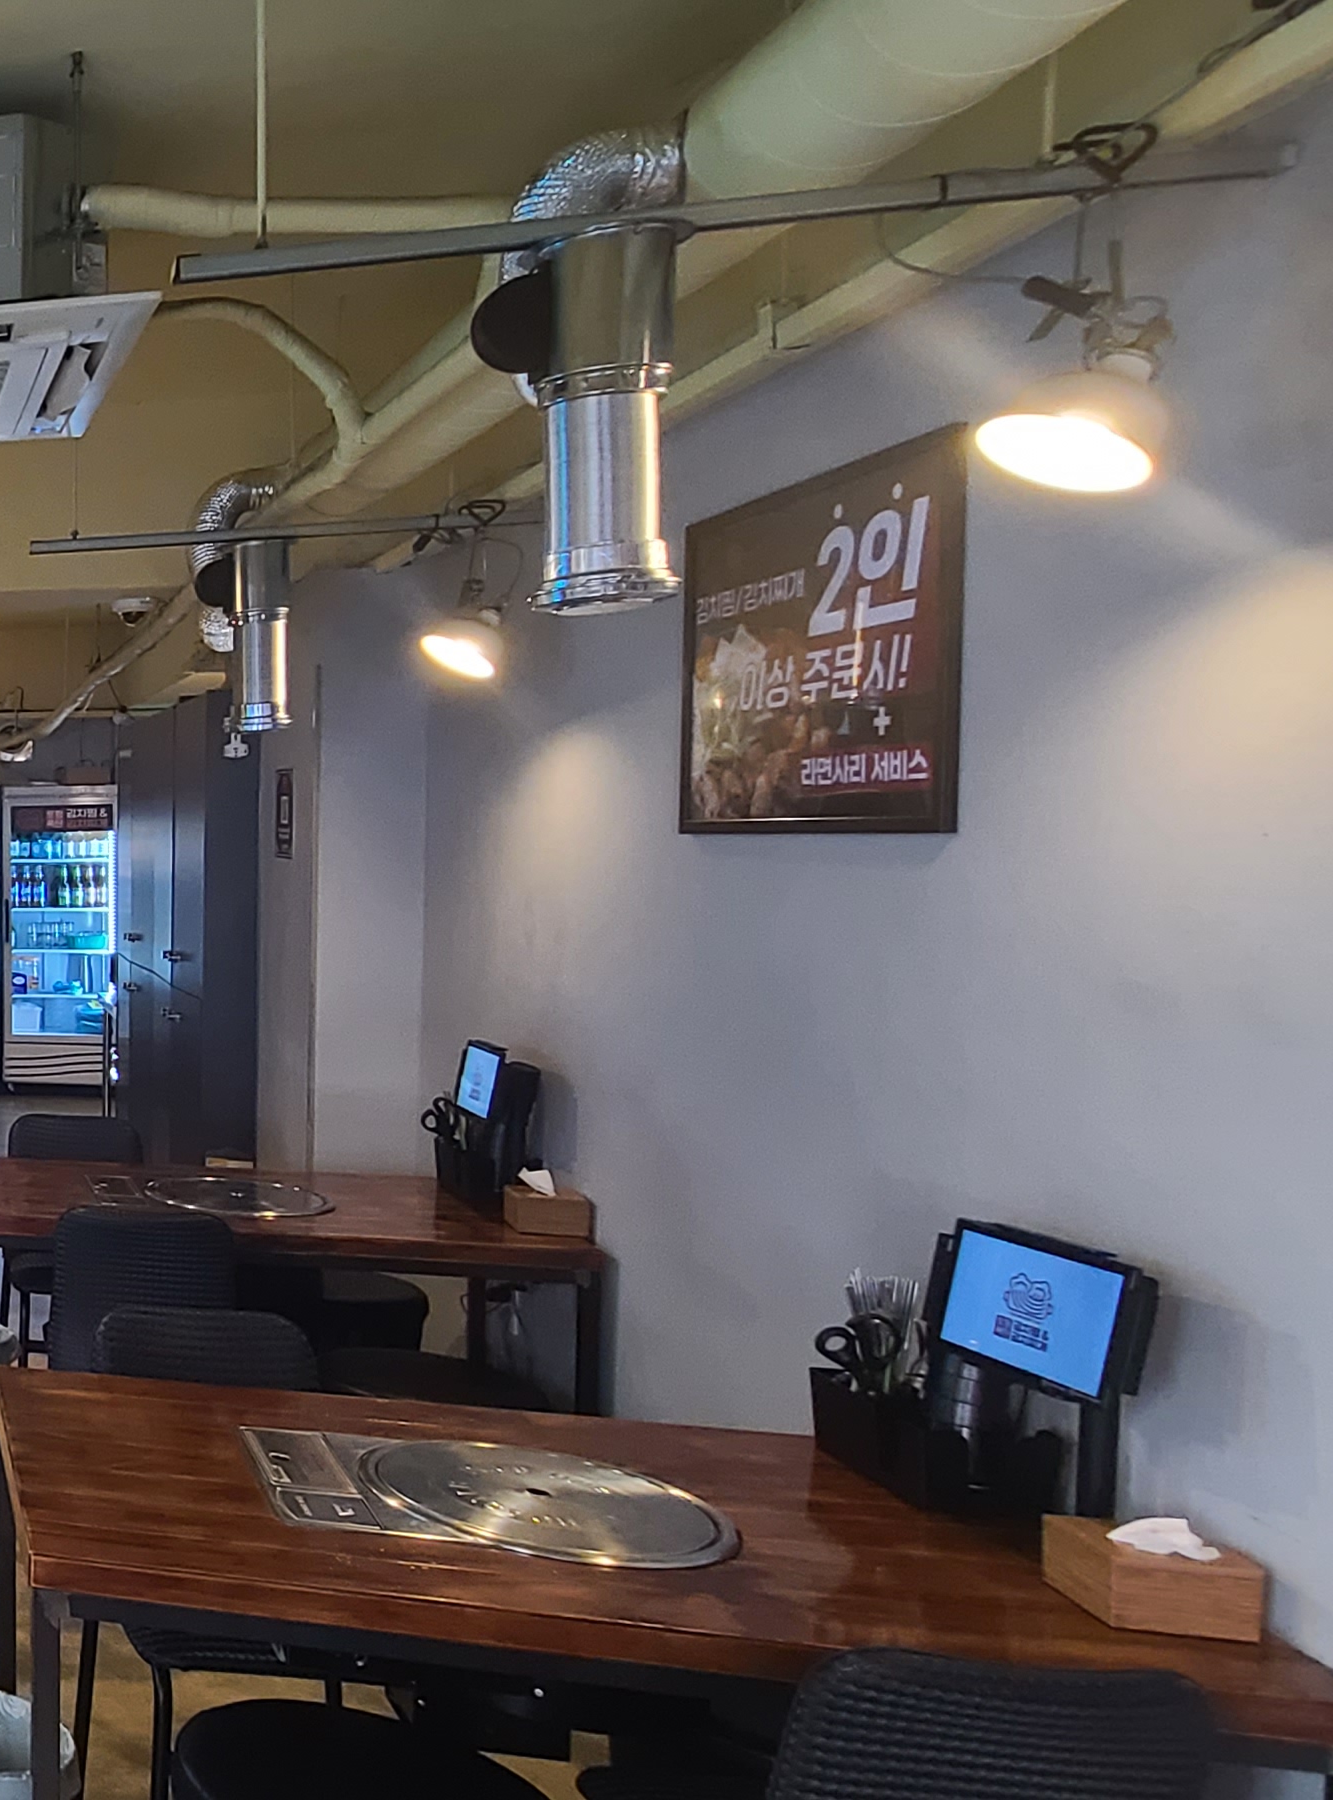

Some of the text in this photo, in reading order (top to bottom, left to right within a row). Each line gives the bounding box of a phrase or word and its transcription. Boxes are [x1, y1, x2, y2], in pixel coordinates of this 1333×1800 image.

[807, 495, 930, 637] 2인
[696, 568, 805, 625] 김치찜/김치찌개
[740, 657, 794, 711] 이상
[801, 750, 929, 786] 라면사리 서비스
